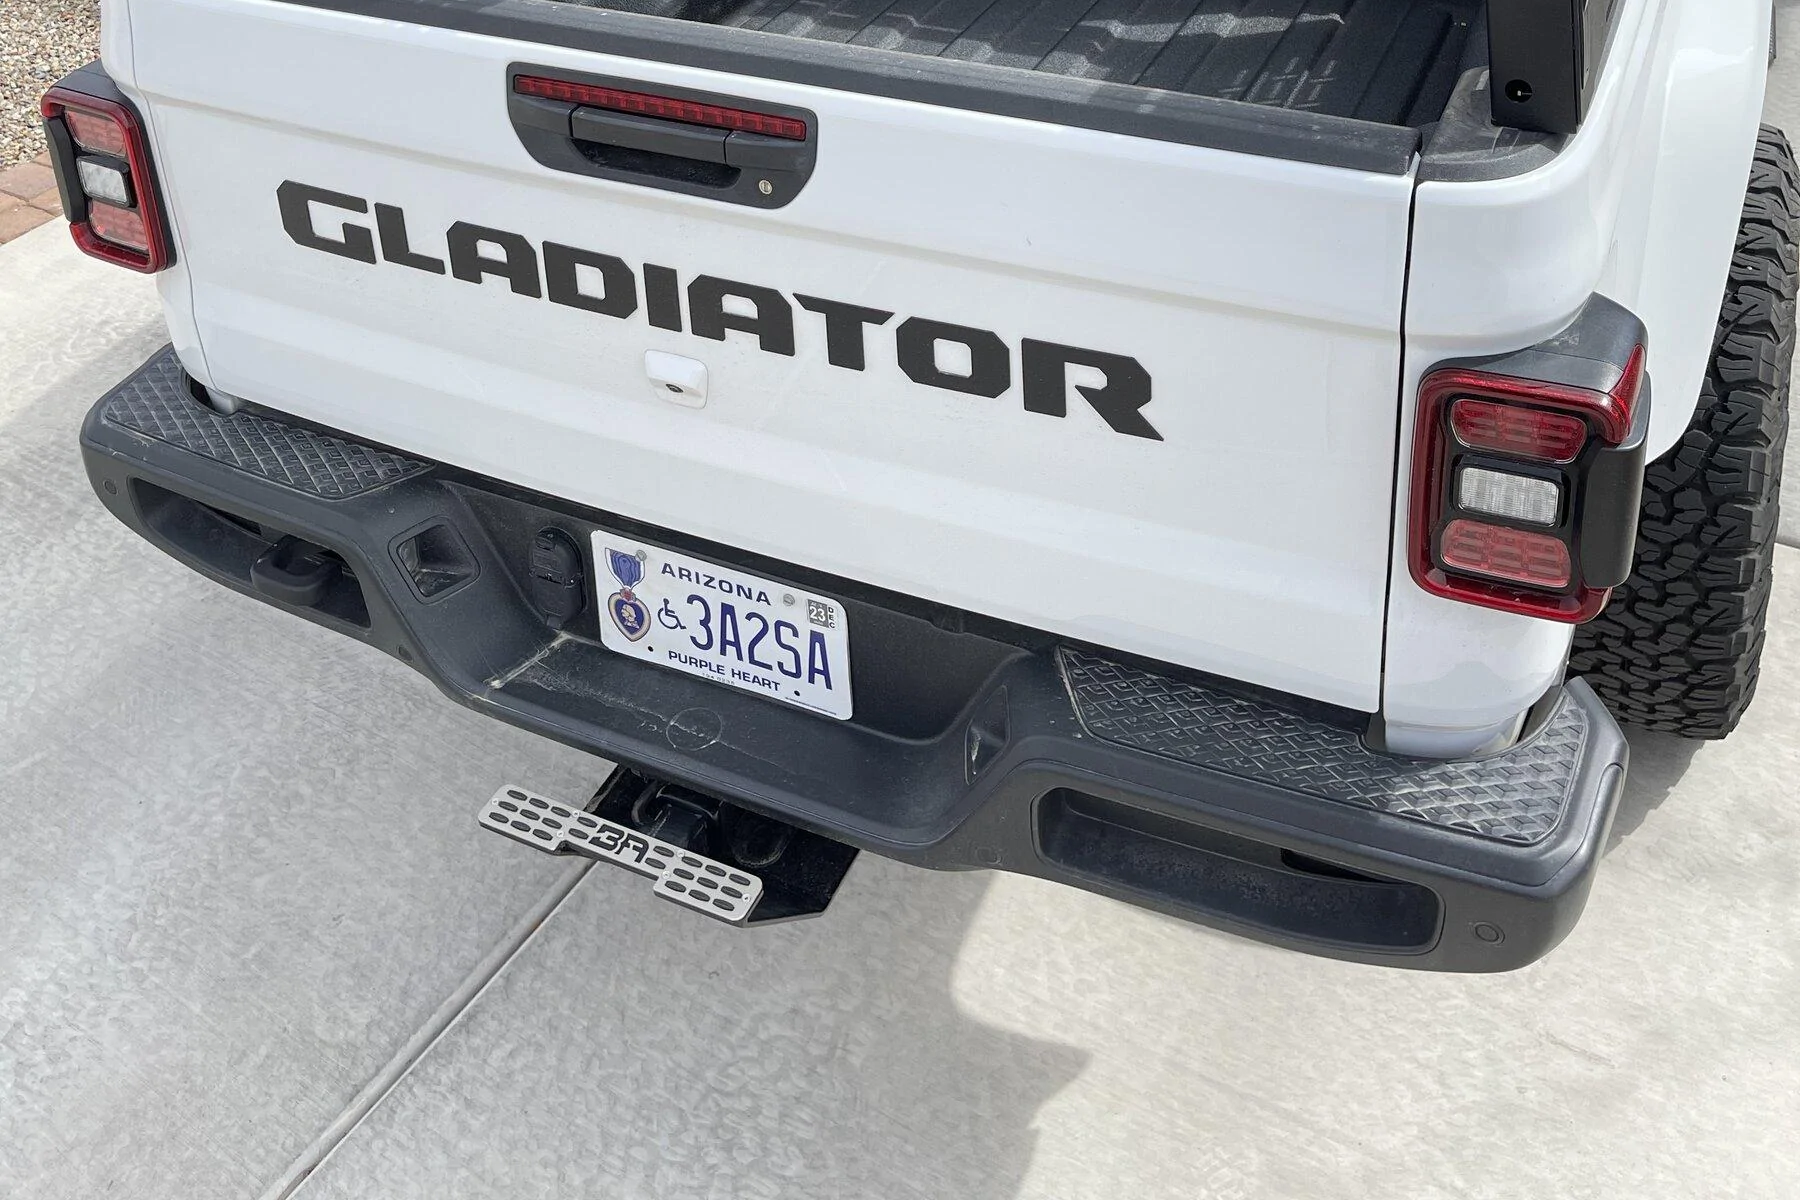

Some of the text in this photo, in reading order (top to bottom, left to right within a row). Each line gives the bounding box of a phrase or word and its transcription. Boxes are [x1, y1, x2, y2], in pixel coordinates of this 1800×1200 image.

[276, 179, 1164, 442] GLADIATOR
[661, 562, 772, 606] ARIZONA
[809, 605, 826, 622] 23
[828, 606, 836, 629] DEC
[686, 593, 833, 691] 3A2SA
[668, 650, 726, 676] PURPLE
[731, 667, 781, 692] HEART
